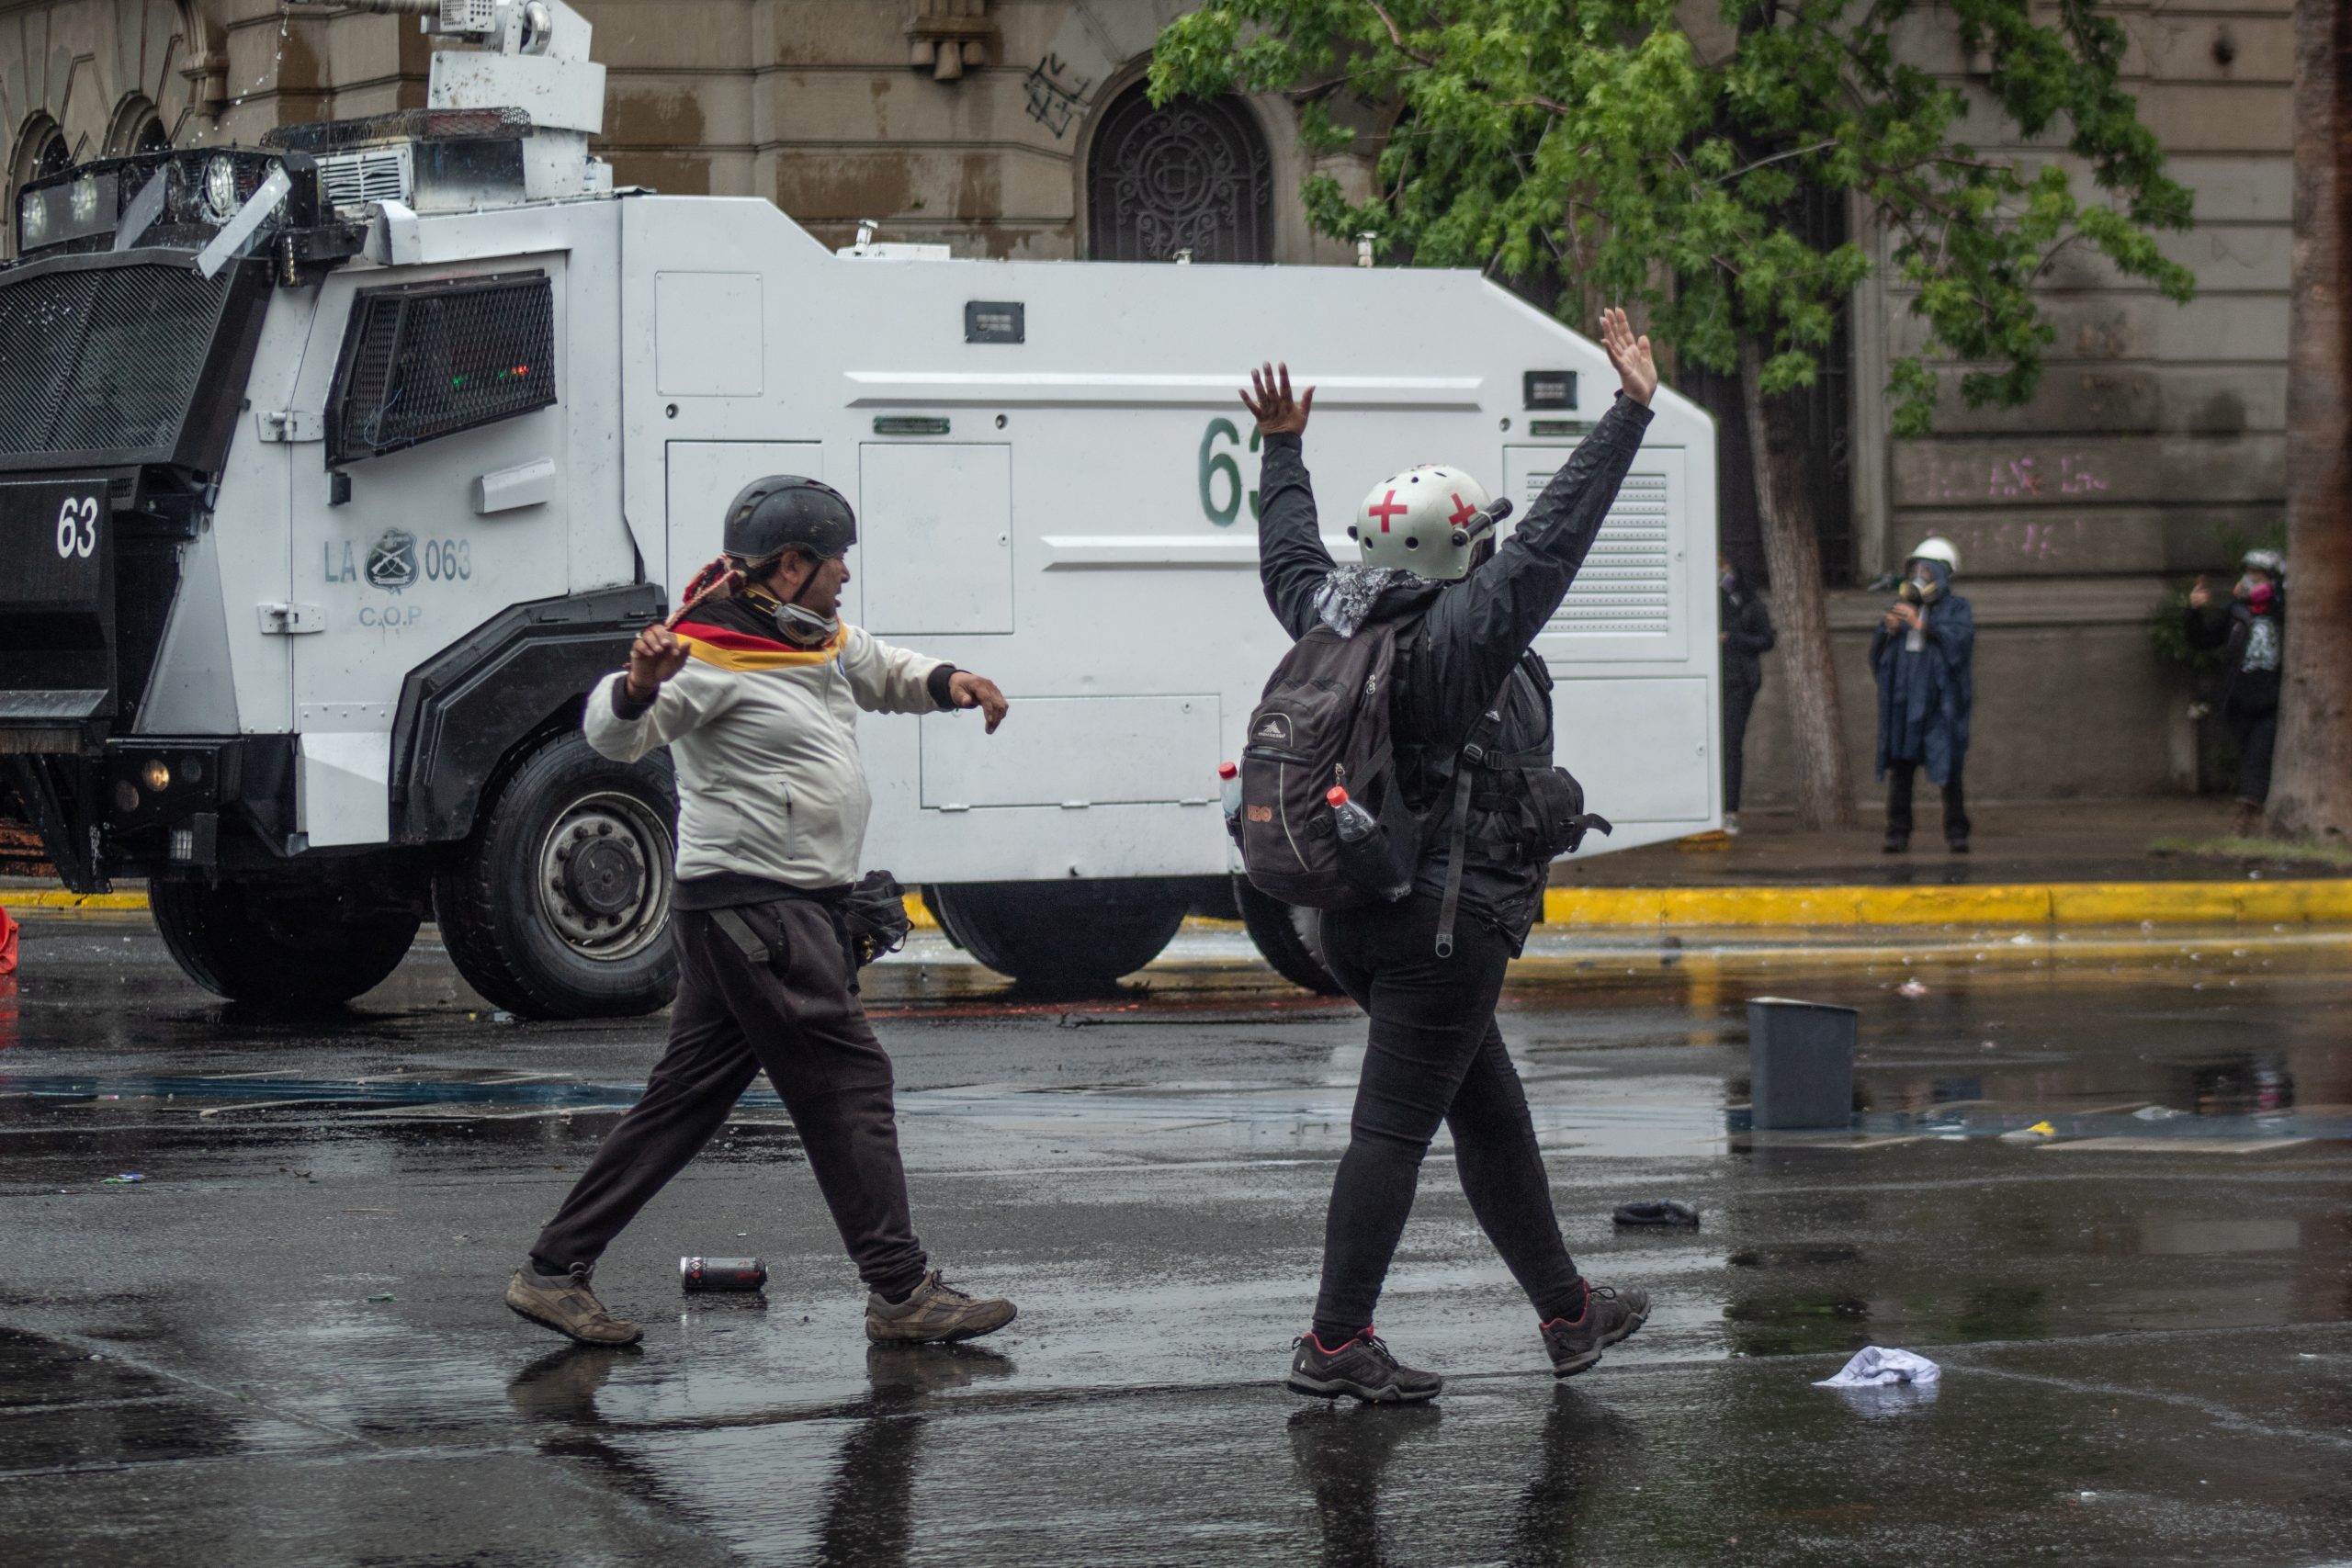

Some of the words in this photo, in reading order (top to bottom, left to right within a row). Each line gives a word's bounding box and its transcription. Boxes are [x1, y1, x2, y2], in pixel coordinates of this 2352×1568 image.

[57, 497, 97, 558] 63
[324, 540, 356, 582] LA
[425, 539, 471, 581] 063
